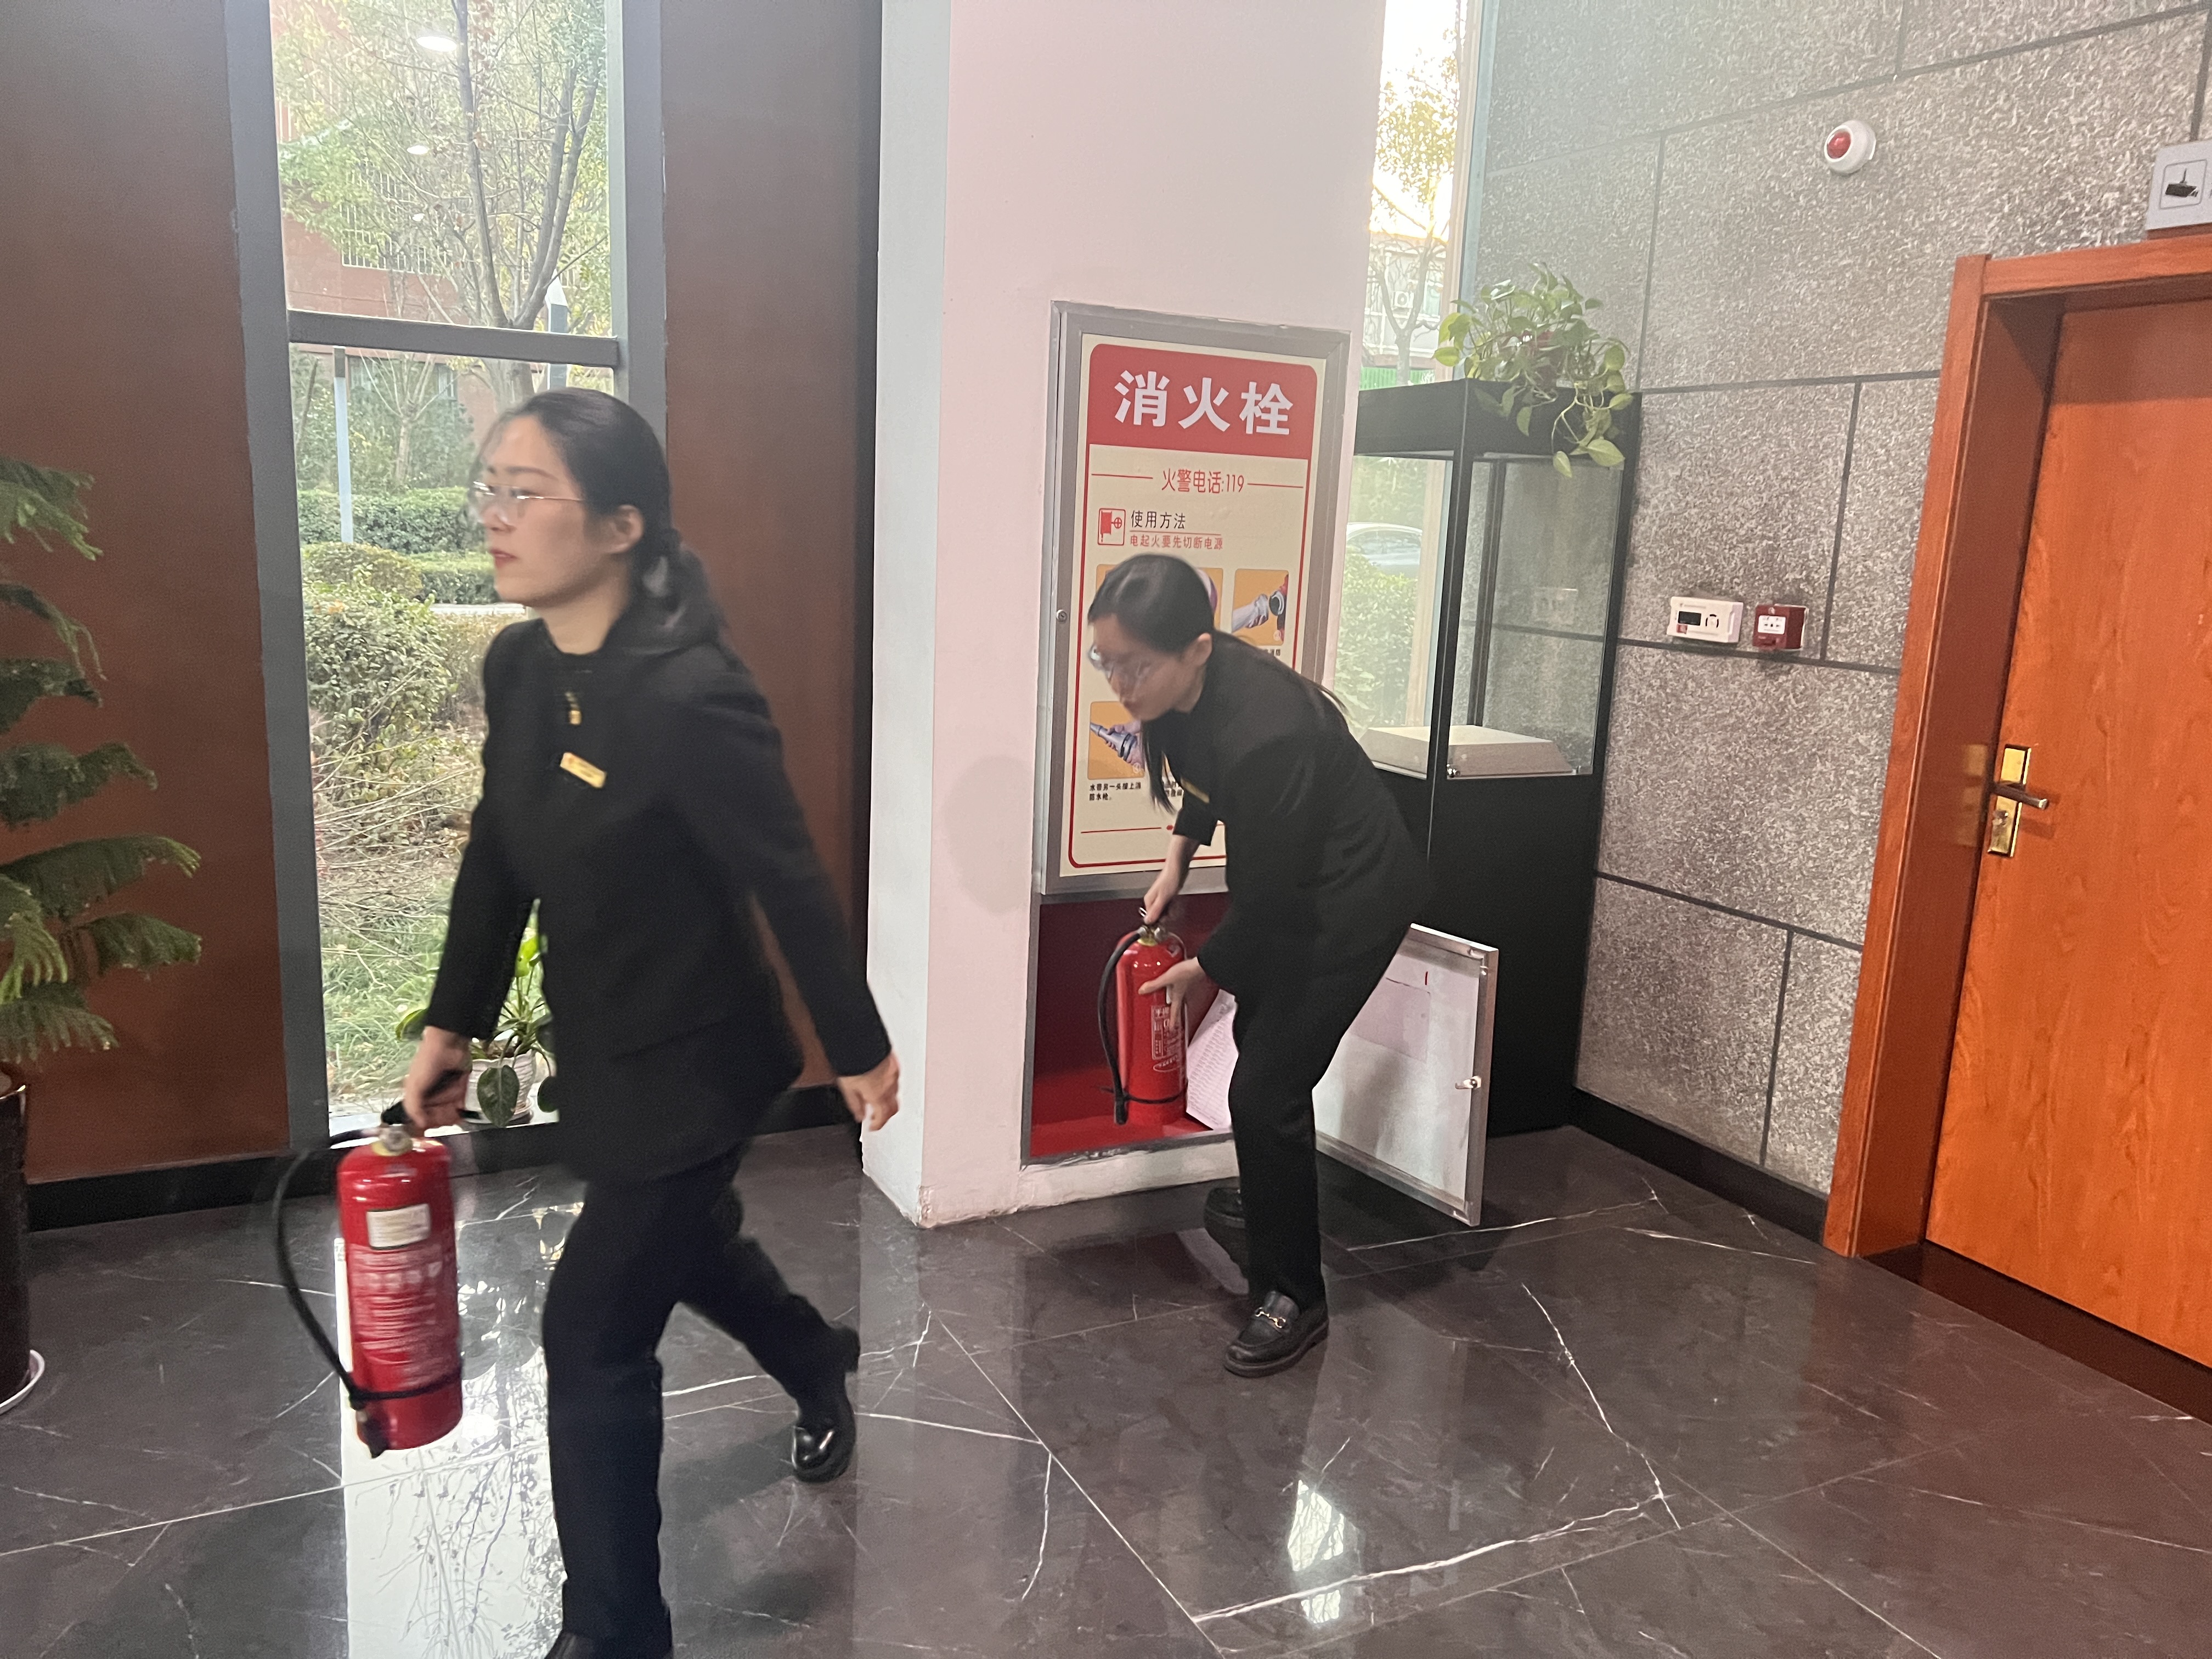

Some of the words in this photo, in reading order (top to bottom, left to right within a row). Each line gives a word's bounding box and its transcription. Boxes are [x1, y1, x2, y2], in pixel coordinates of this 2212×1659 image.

[1114, 369, 1294, 436] 消火栓
[1161, 467, 1245, 494] 火警电话:119
[1131, 510, 1186, 529] 使用方法
[1130, 534, 1223, 550] 电起火要先切断电源
